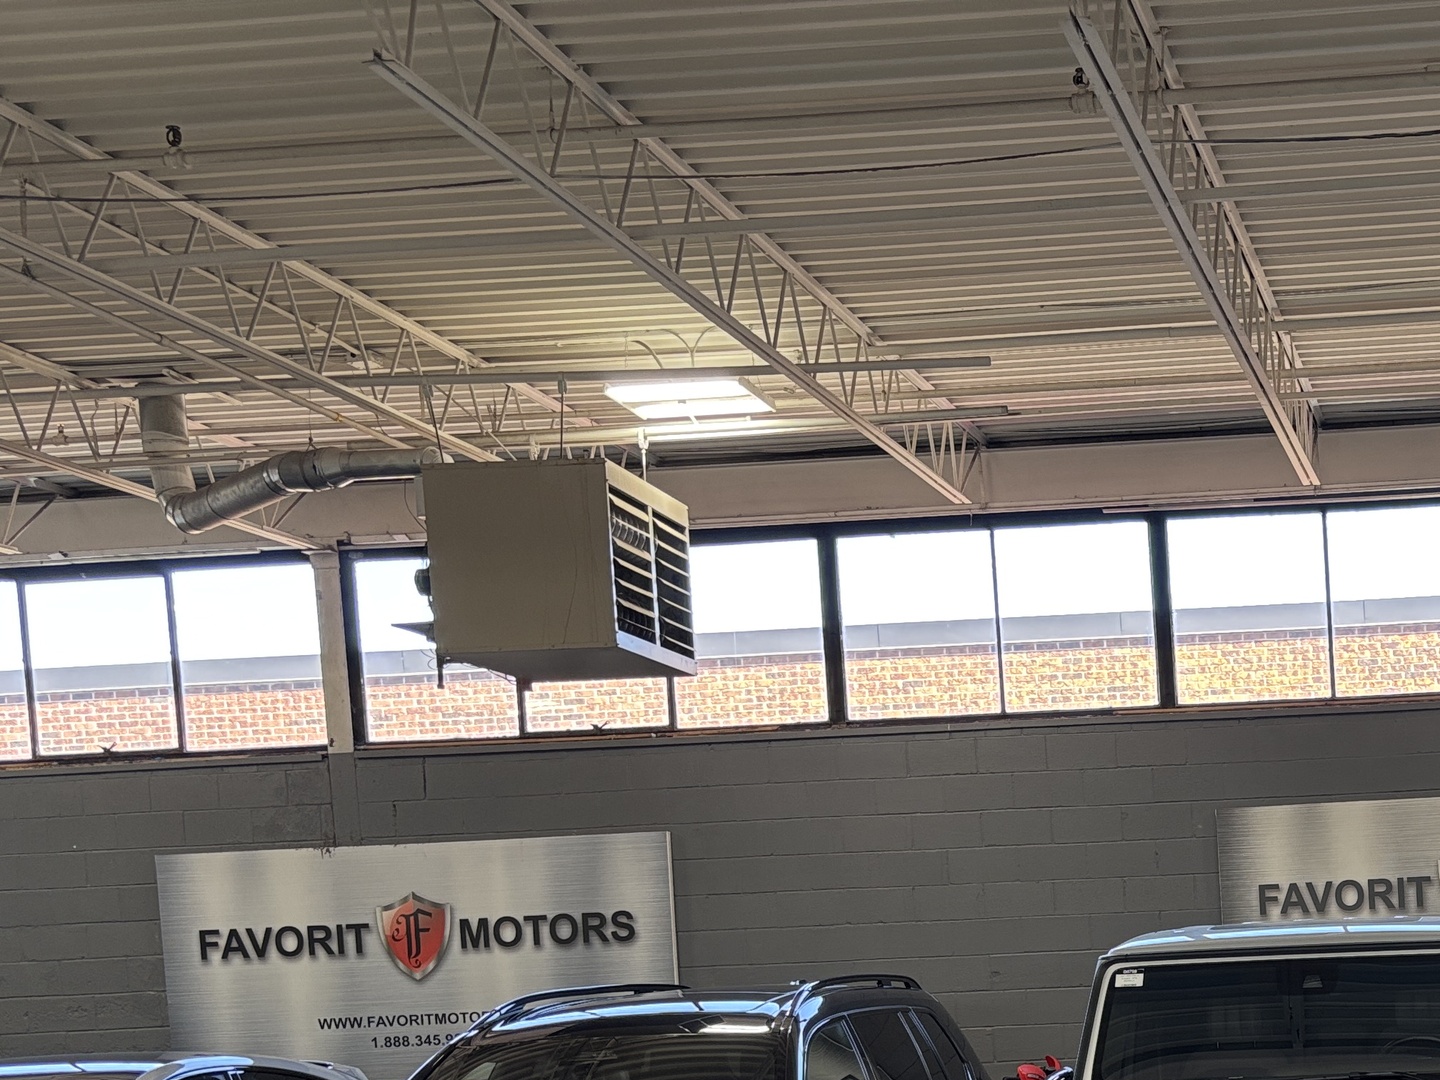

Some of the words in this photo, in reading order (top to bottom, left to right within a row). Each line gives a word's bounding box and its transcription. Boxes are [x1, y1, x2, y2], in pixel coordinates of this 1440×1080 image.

[1258, 875, 1431, 915] FAVORIT
[199, 922, 370, 961] FAVORIT
[460, 910, 636, 950] MOTORS
[371, 1033, 460, 1049] 1.888.345.9
